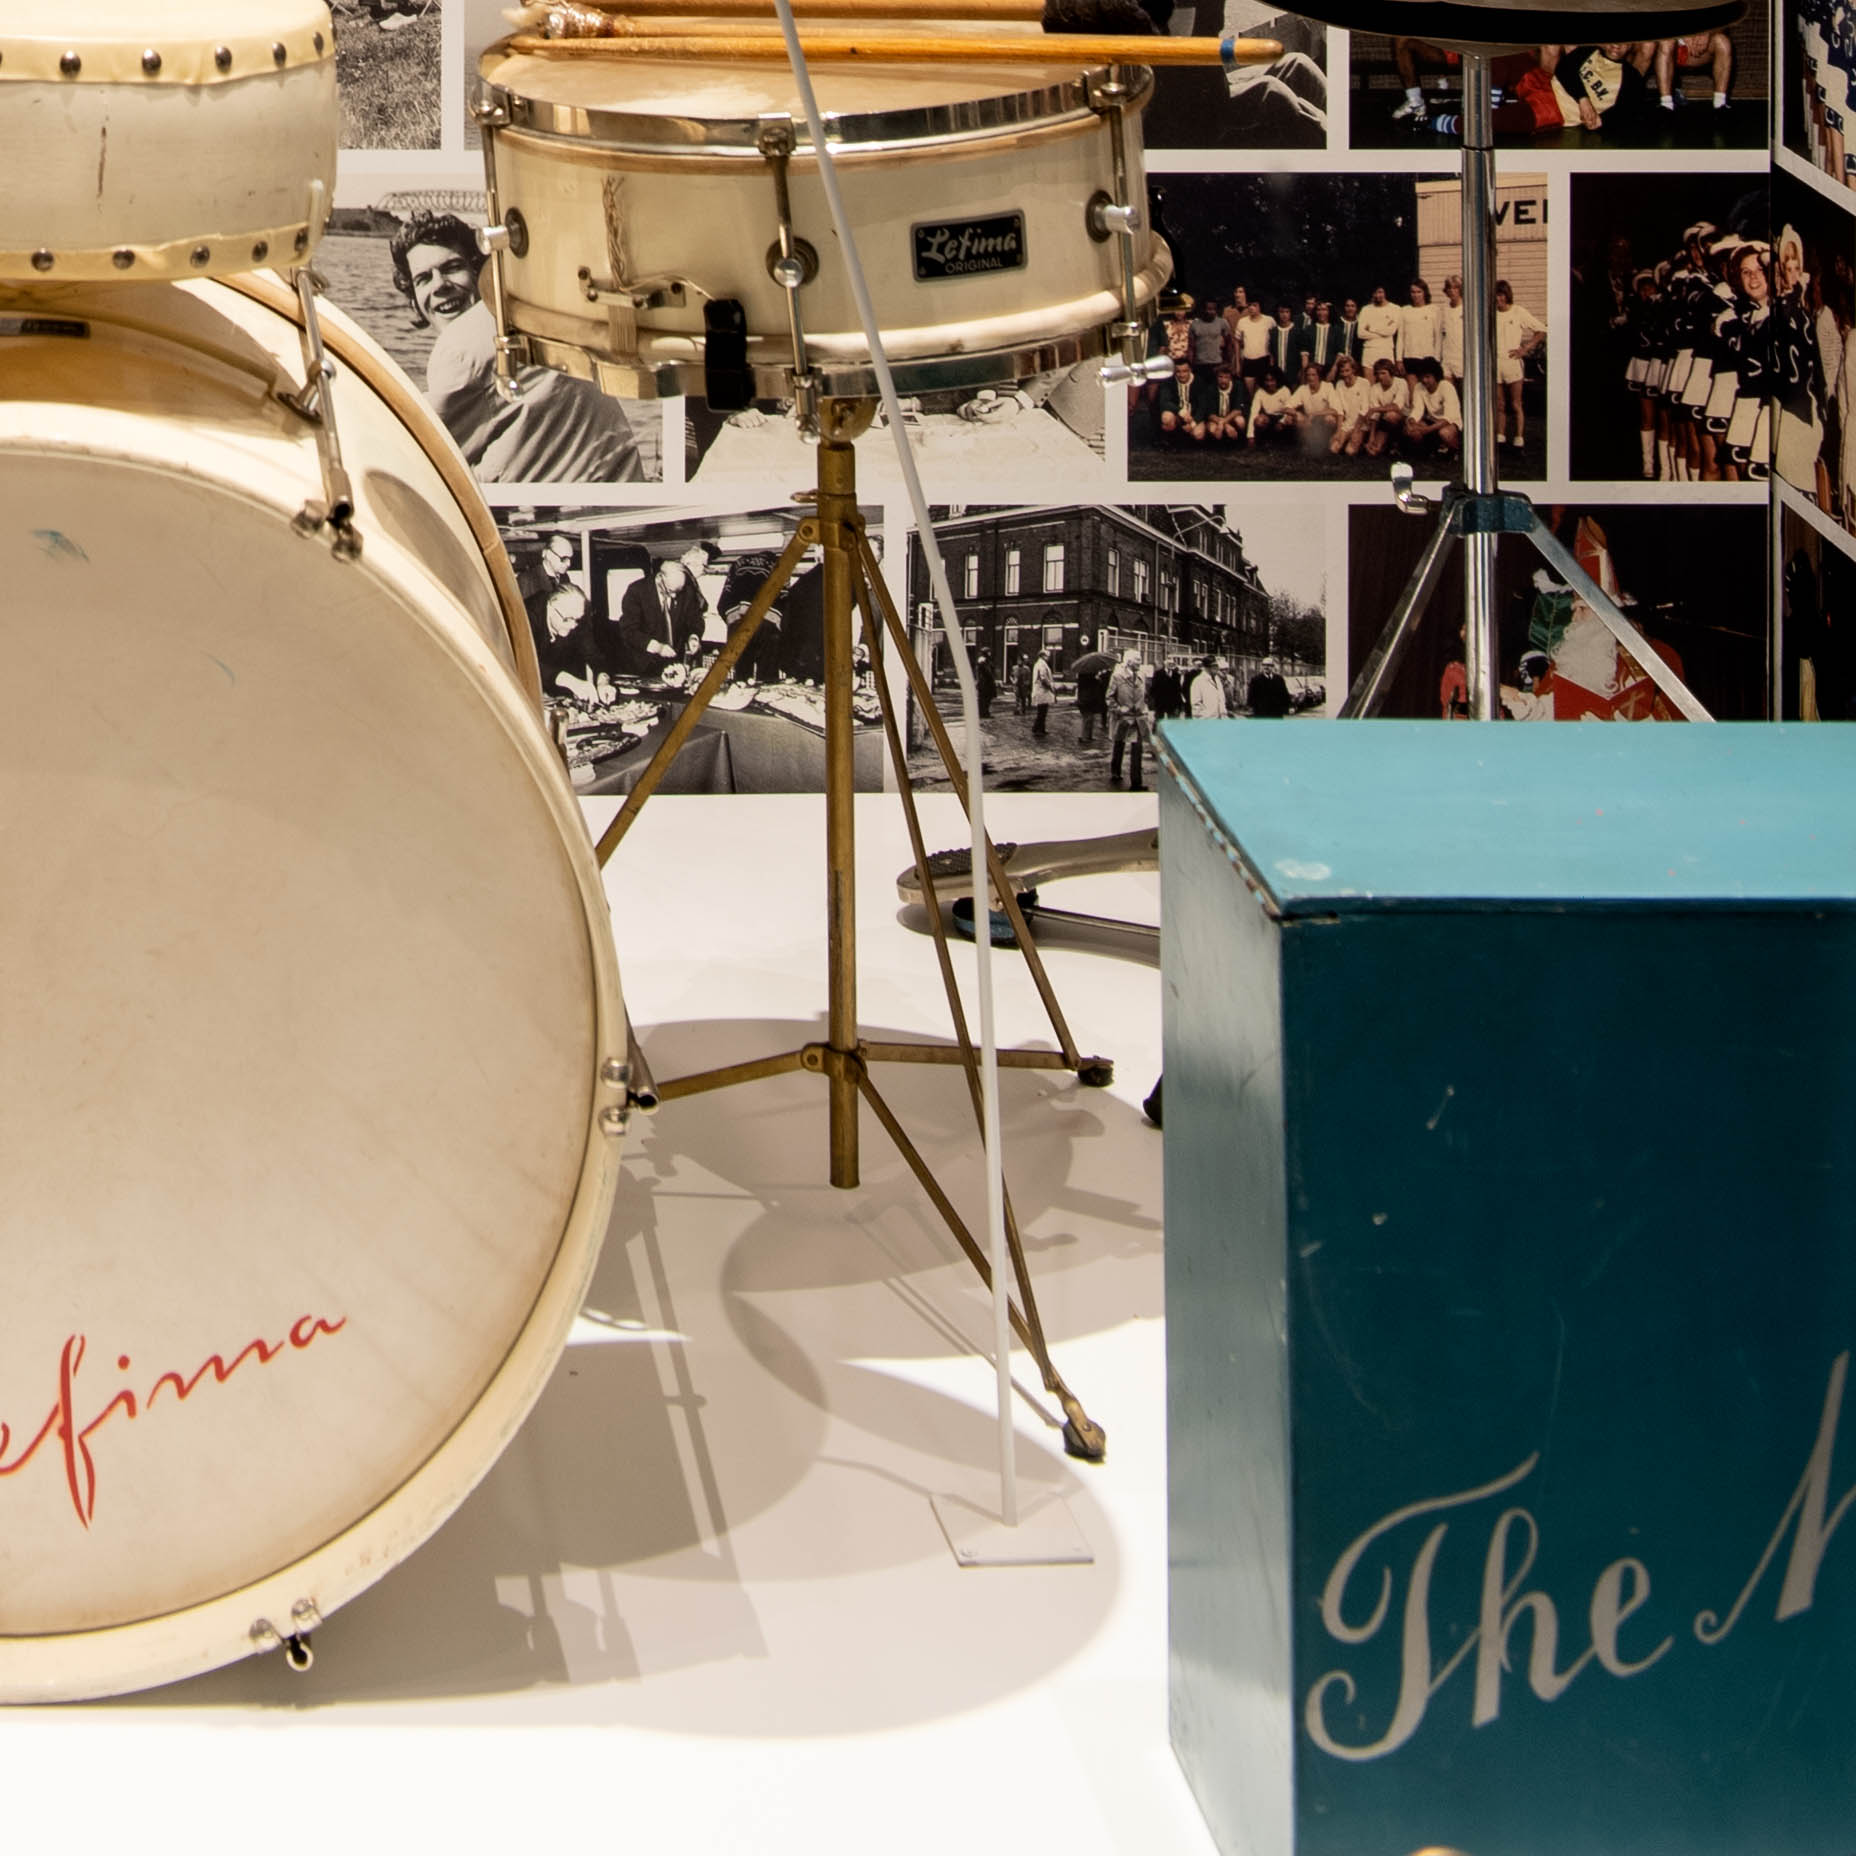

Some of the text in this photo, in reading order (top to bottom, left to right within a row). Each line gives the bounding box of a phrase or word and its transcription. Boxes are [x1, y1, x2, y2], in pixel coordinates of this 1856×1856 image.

[921, 226, 1017, 264] Lefima
[945, 256, 1004, 274] ORIGINAL
[1305, 1450, 1675, 1762] The
